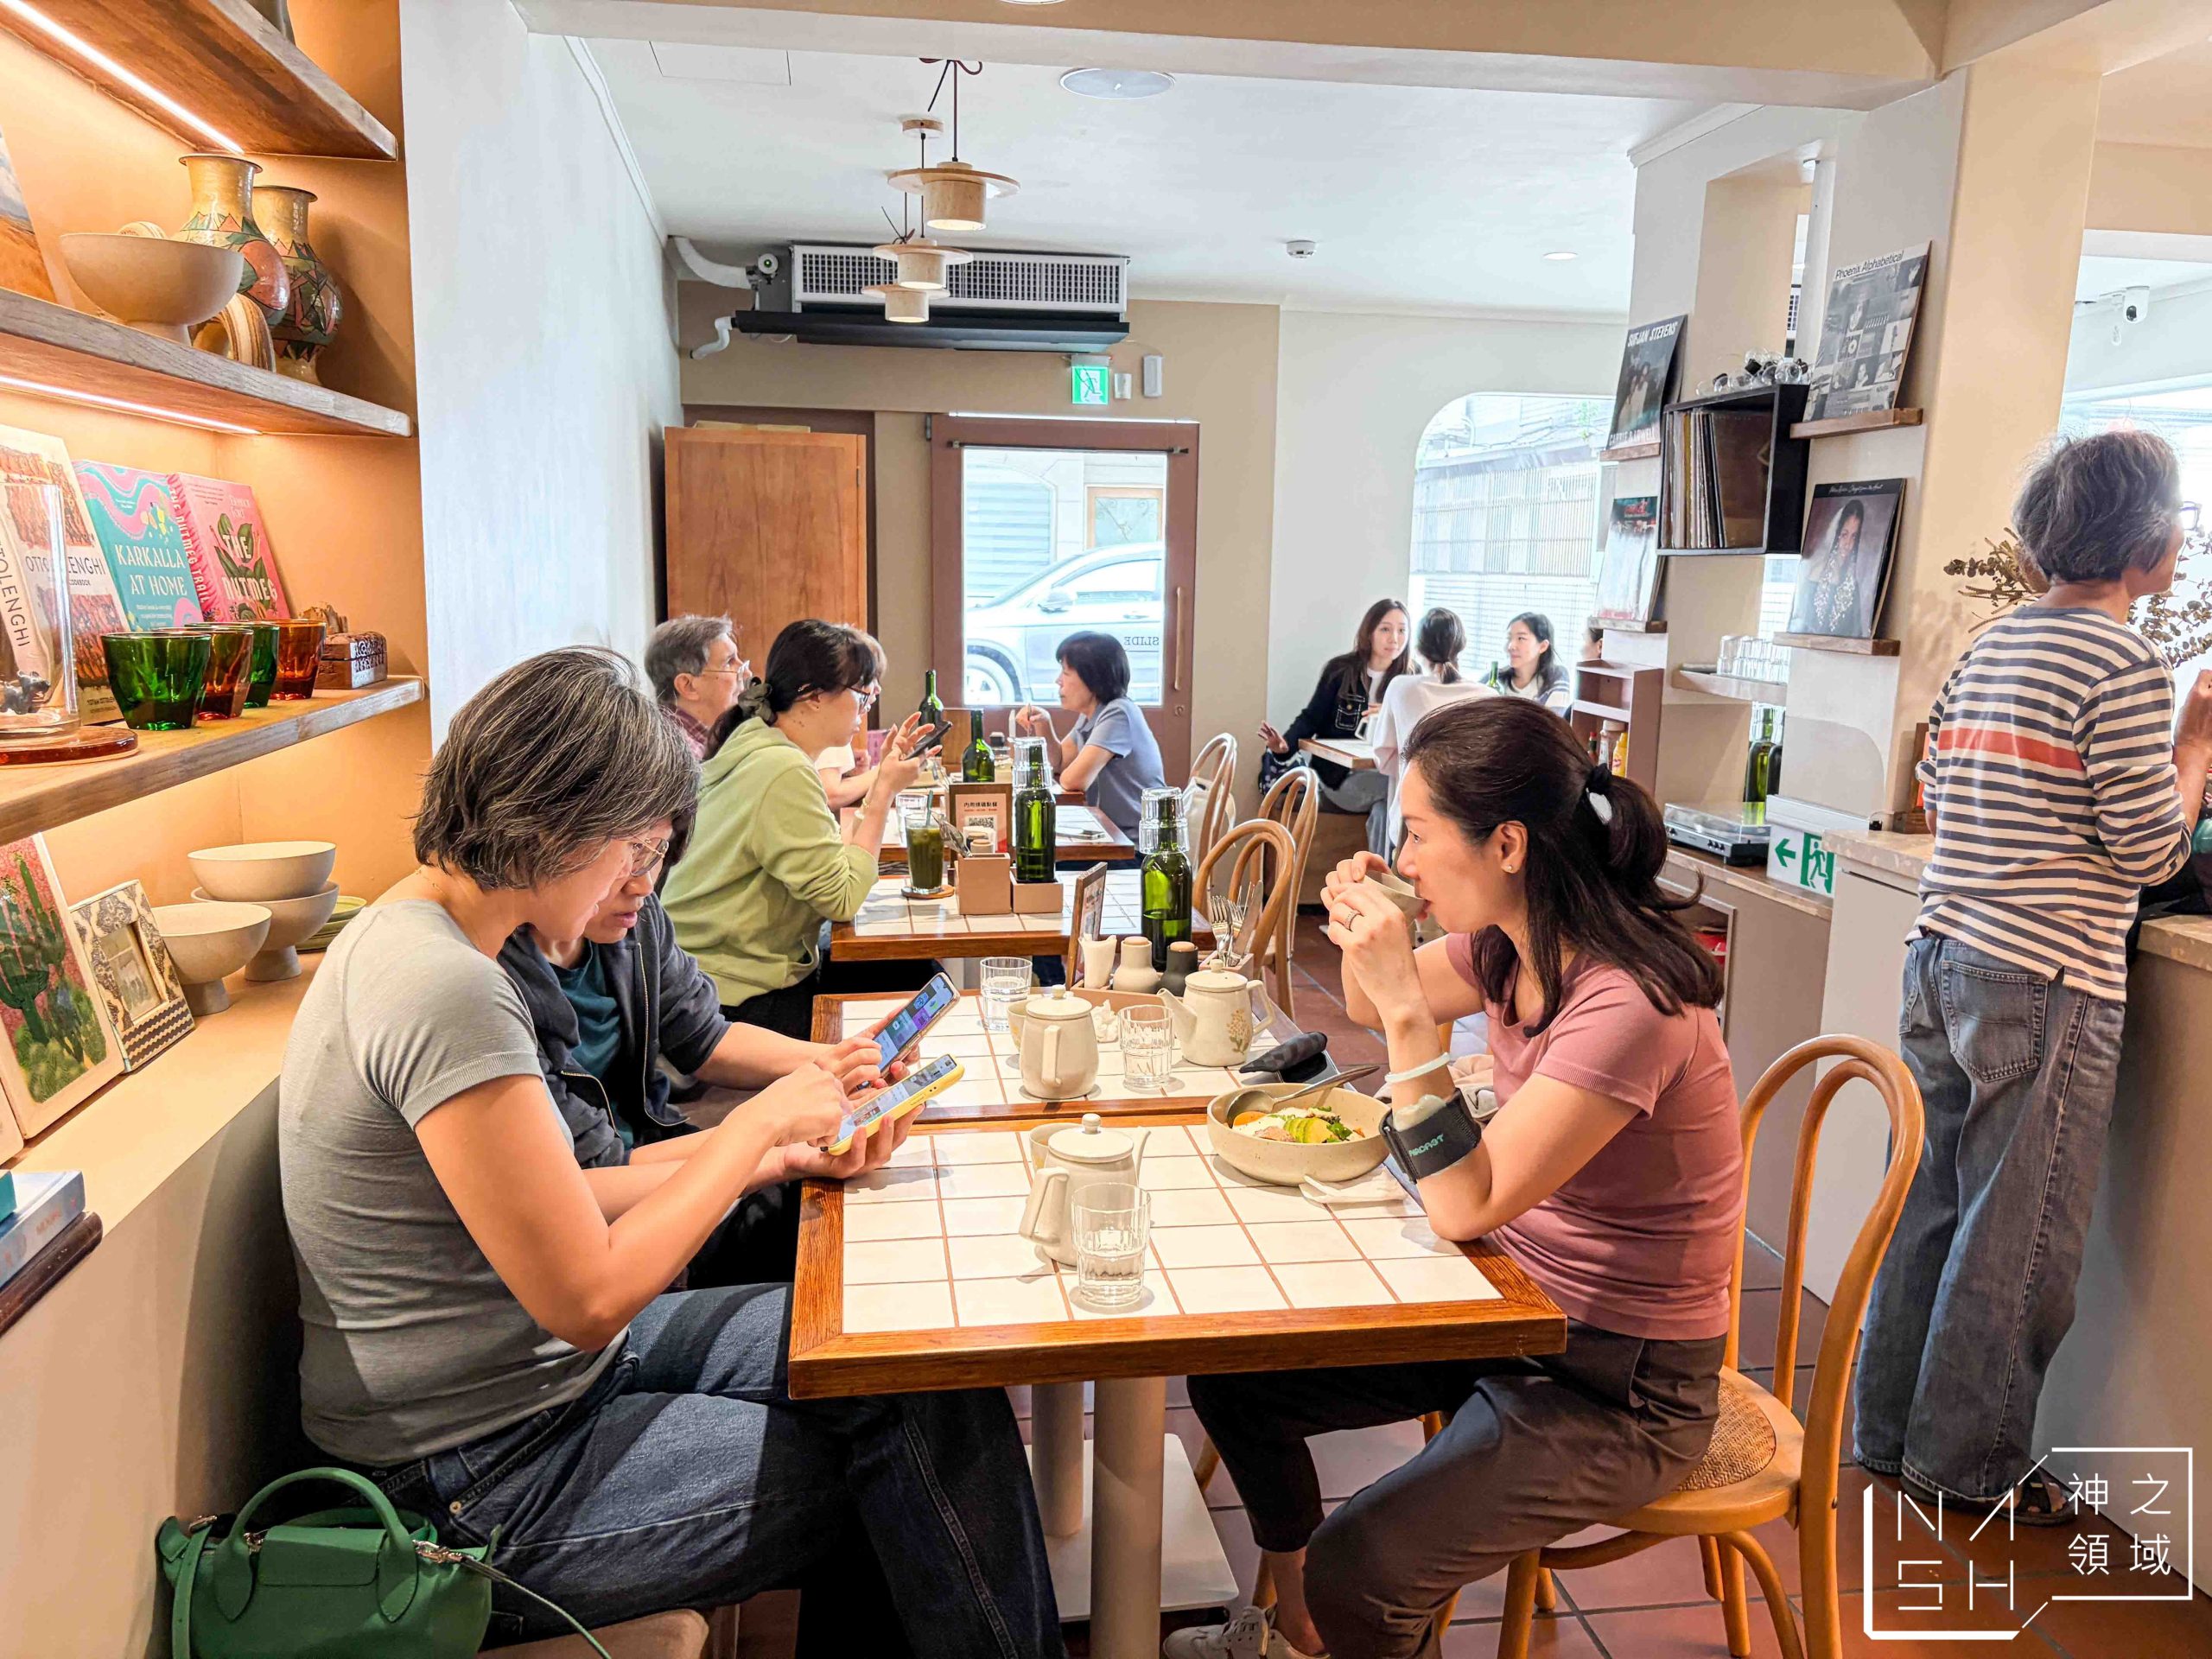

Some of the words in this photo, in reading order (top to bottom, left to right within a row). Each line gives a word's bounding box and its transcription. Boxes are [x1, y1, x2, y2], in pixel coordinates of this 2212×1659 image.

[1835, 264, 1861, 280] Phoenix
[1861, 251, 1904, 272] Alphabetical
[1649, 321, 1678, 342] STEVENS
[114, 544, 186, 569] KARKALLA
[169, 490, 181, 510] THE
[175, 516, 198, 564] NUTMEG
[191, 569, 210, 603] TRAIL
[222, 534, 252, 559] THE
[130, 574, 144, 595] AT
[149, 575, 188, 596] HOME
[222, 576, 277, 601] NUTMEG
